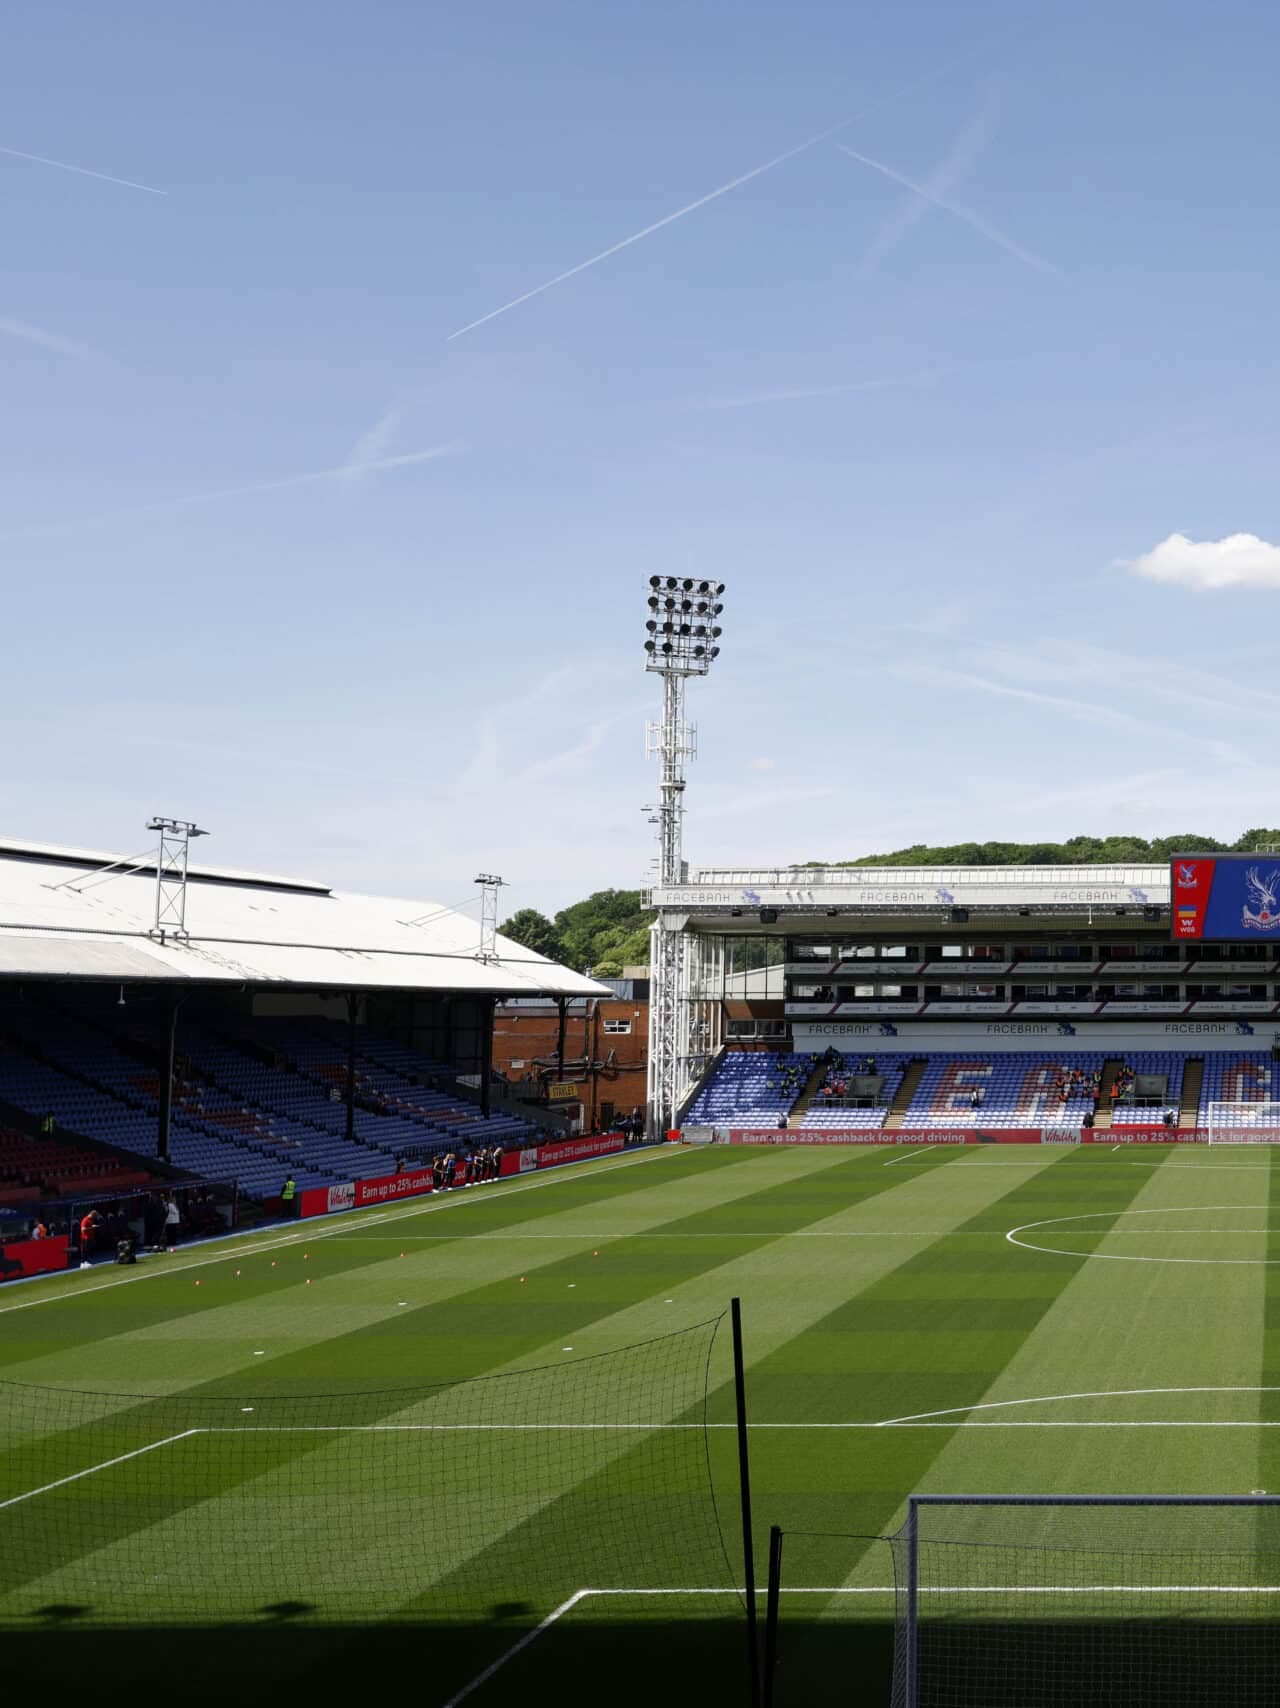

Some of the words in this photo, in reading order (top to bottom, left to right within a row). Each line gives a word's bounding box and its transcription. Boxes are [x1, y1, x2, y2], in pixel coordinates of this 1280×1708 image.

[666, 892, 731, 902] FACEBANK
[859, 891, 925, 901] FACEBANK
[808, 1024, 870, 1034] FACEBANK
[986, 1024, 1048, 1034] FACEBANK
[1164, 1023, 1226, 1033] FACEBANK
[785, 1132, 797, 1142] to
[799, 1132, 825, 1142] 25%
[826, 1132, 875, 1142] cashback
[878, 1132, 893, 1142] for
[896, 1132, 925, 1144] good
[927, 1132, 965, 1144] driving
[1093, 1132, 1117, 1141] Earn
[1119, 1133, 1134, 1144] up
[1136, 1132, 1148, 1141] to
[362, 1186, 378, 1199] Earn
[378, 1185, 388, 1198] up
[389, 1183, 397, 1193] to
[397, 1178, 412, 1192] 25%
